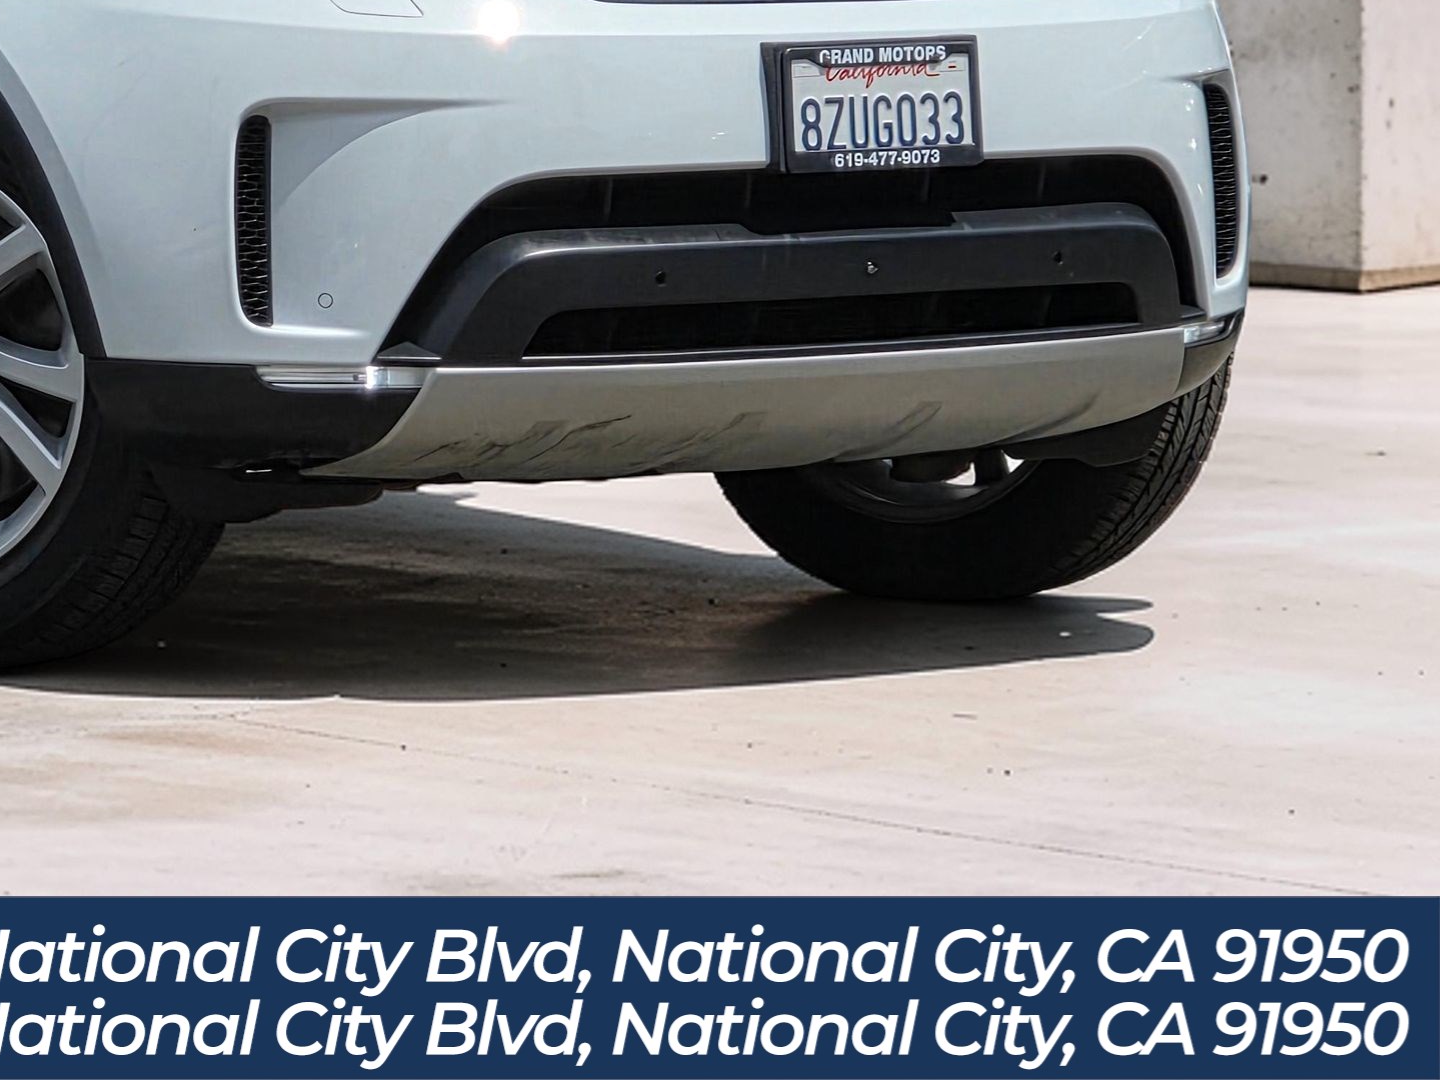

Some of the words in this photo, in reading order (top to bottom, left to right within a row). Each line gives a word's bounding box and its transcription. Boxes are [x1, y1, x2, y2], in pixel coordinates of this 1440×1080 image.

[819, 47, 875, 65] GRAND
[878, 45, 947, 63] MOTORS
[800, 90, 965, 152] 8ZUG033
[833, 149, 942, 168] 619-477-9073
